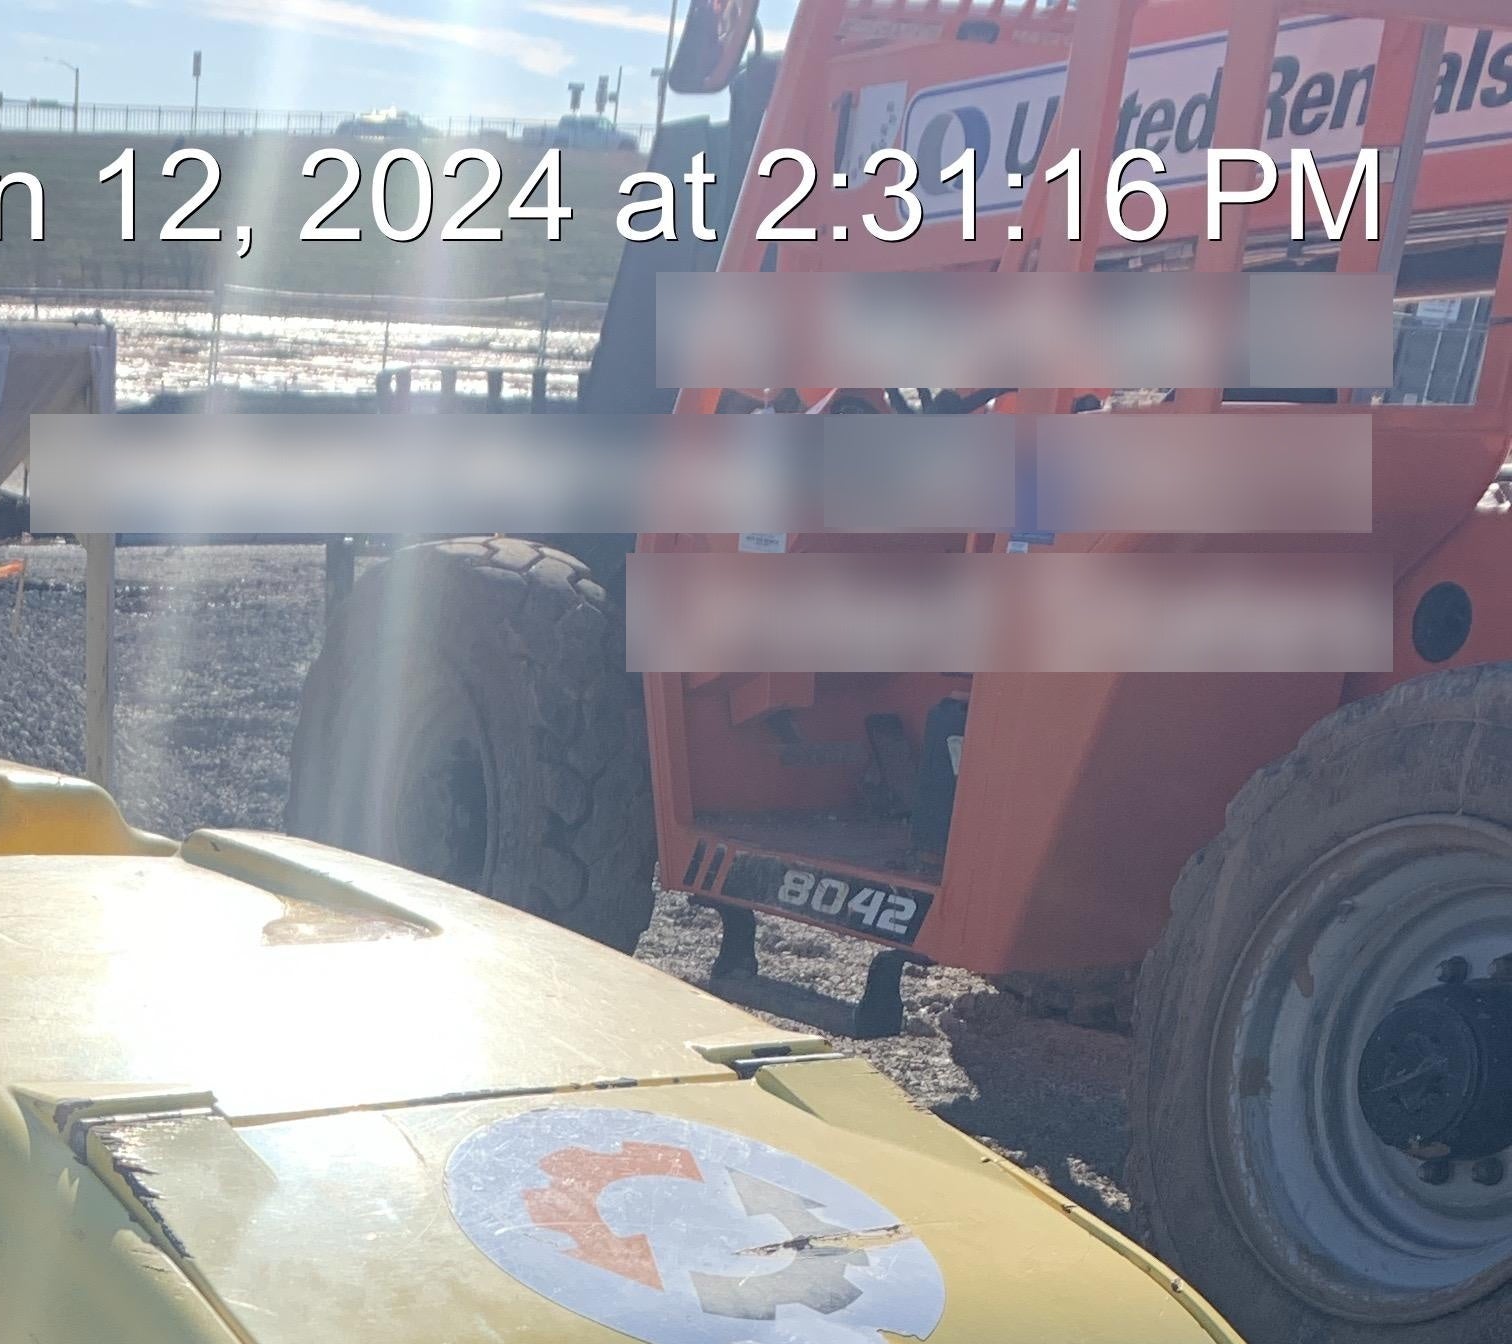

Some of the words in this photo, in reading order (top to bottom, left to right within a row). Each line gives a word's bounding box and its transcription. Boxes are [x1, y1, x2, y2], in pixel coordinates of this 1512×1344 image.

[1004, 66, 1224, 176] Uted
[1264, 30, 1512, 140] Renals
[777, 869, 918, 934] 8042
